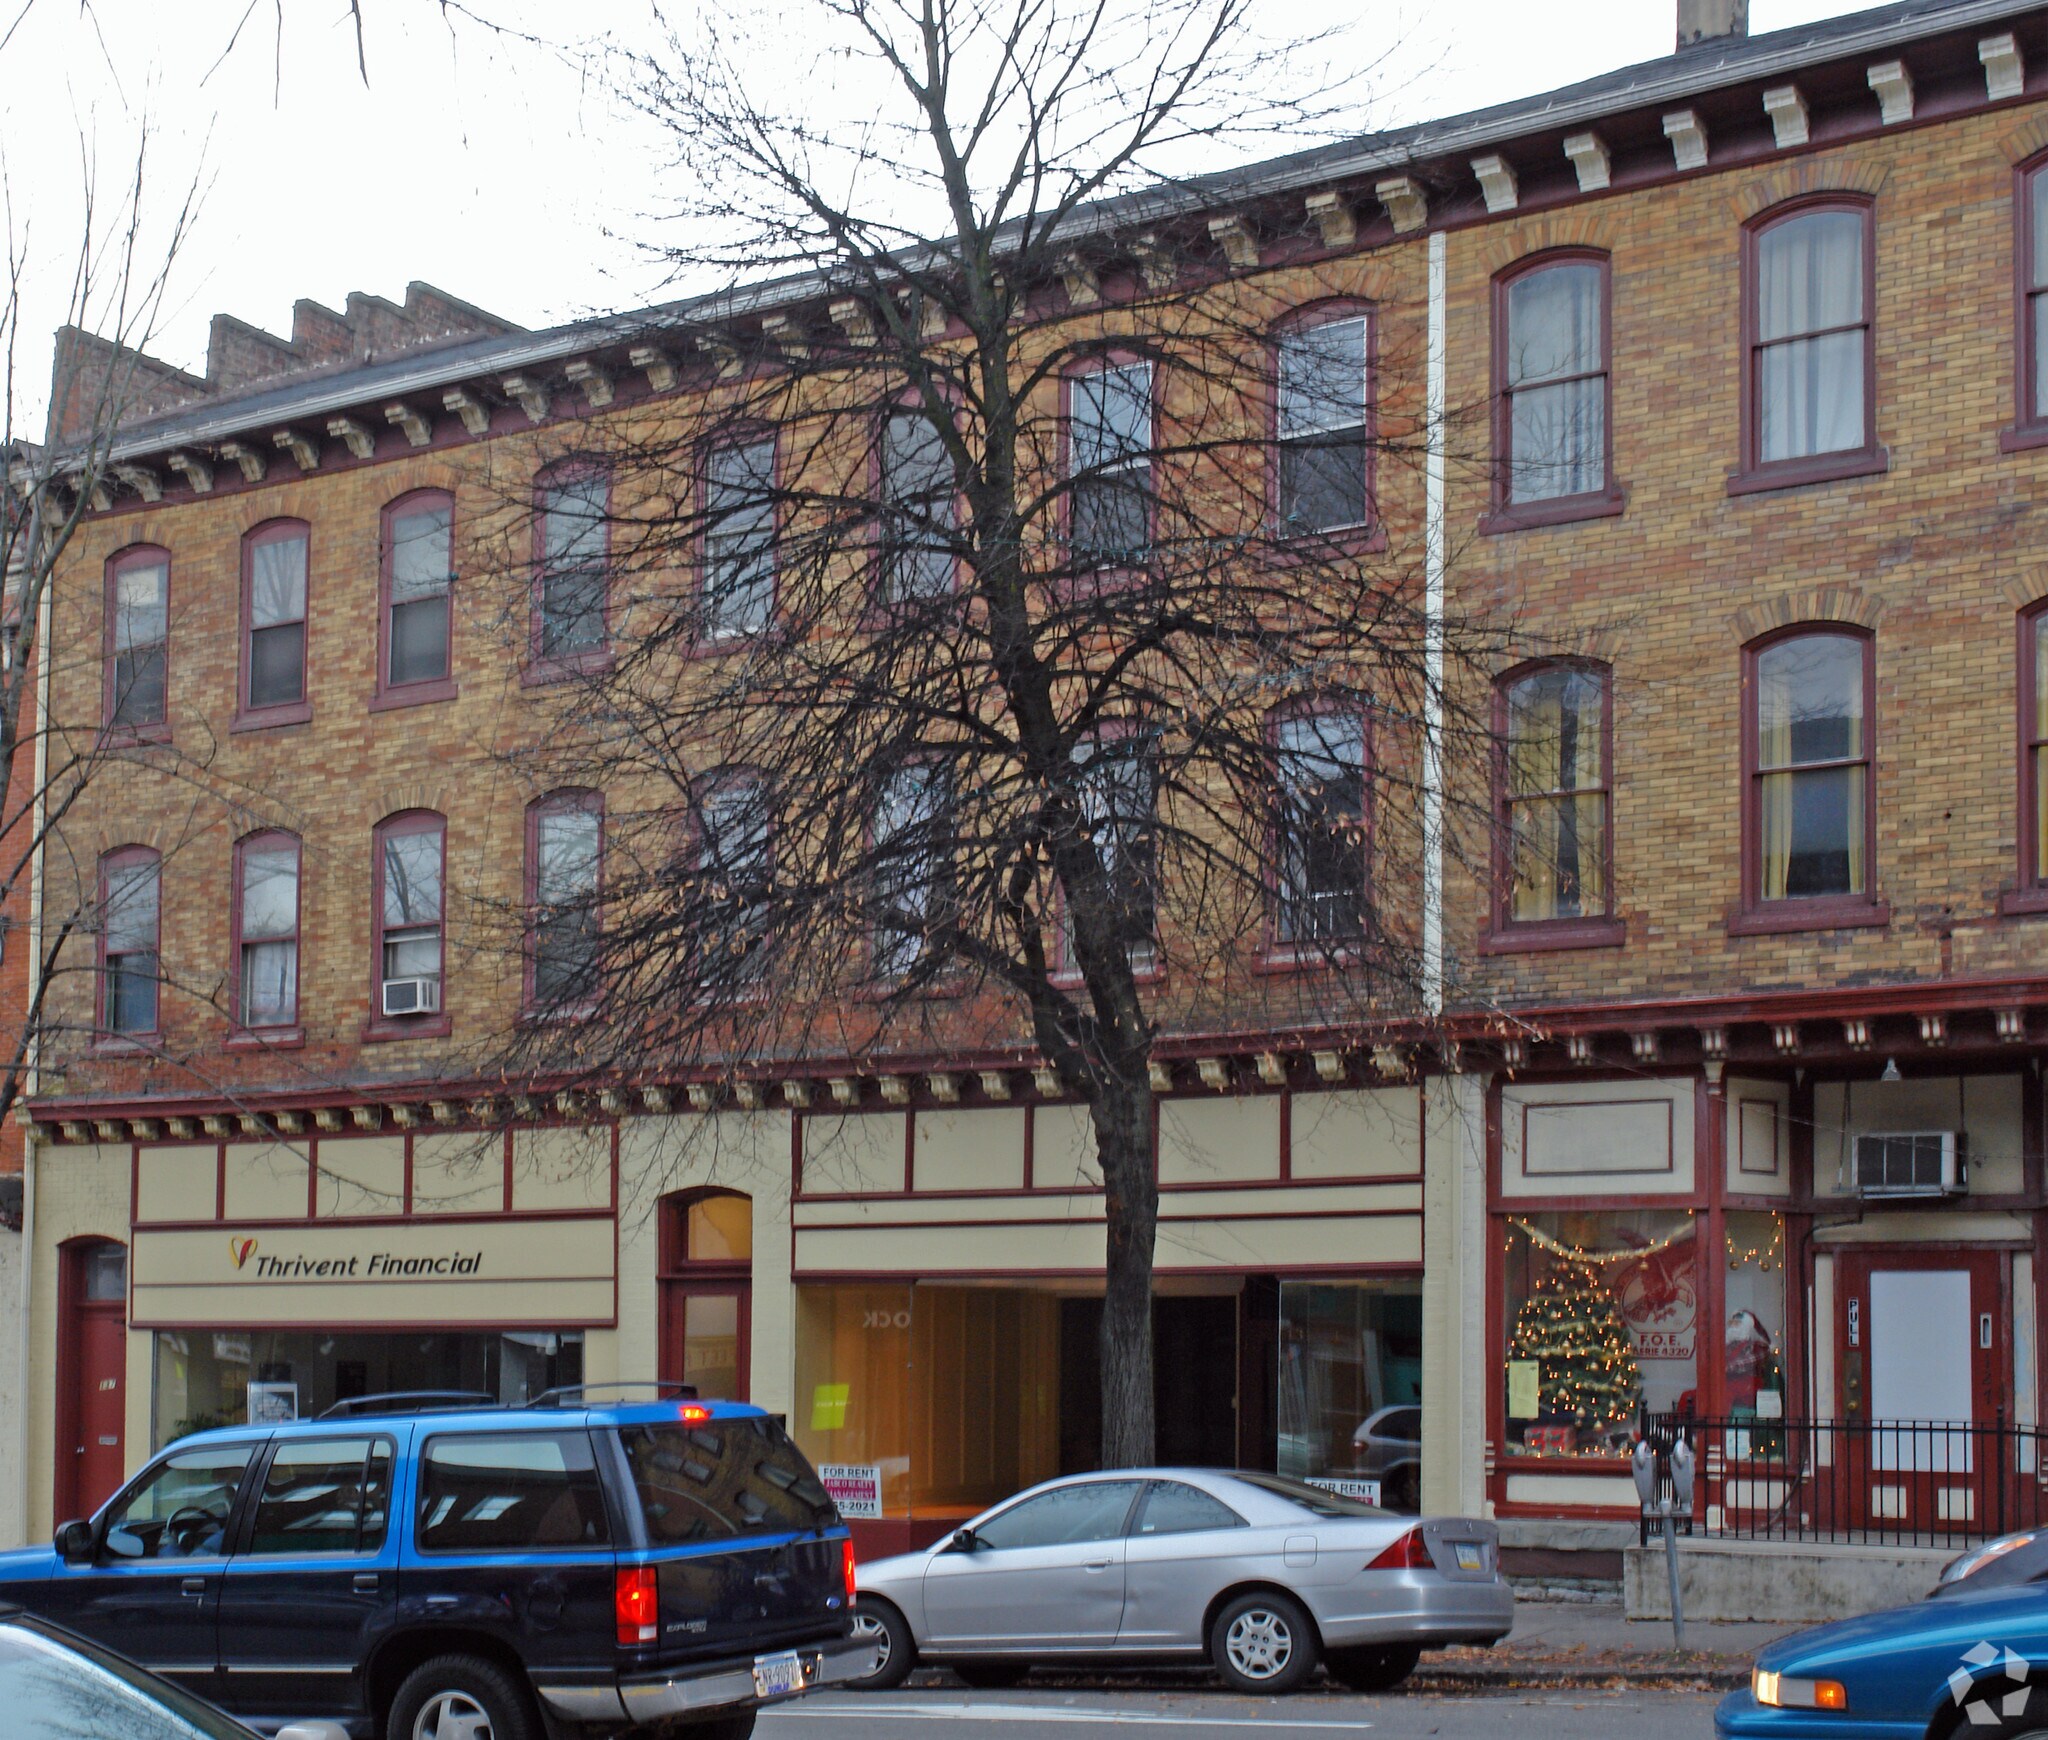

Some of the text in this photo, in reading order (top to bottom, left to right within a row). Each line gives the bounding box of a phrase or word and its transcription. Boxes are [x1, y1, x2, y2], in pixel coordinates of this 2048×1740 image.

[257, 1251, 483, 1278] Thrivent Financial
[1849, 1300, 1857, 1346] PULL
[1632, 1347, 1689, 1357] AERIE 4320
[823, 1467, 875, 1479] FOR RENT
[848, 1479, 873, 1489] REALTY
[1340, 1482, 1373, 1495] RENT
